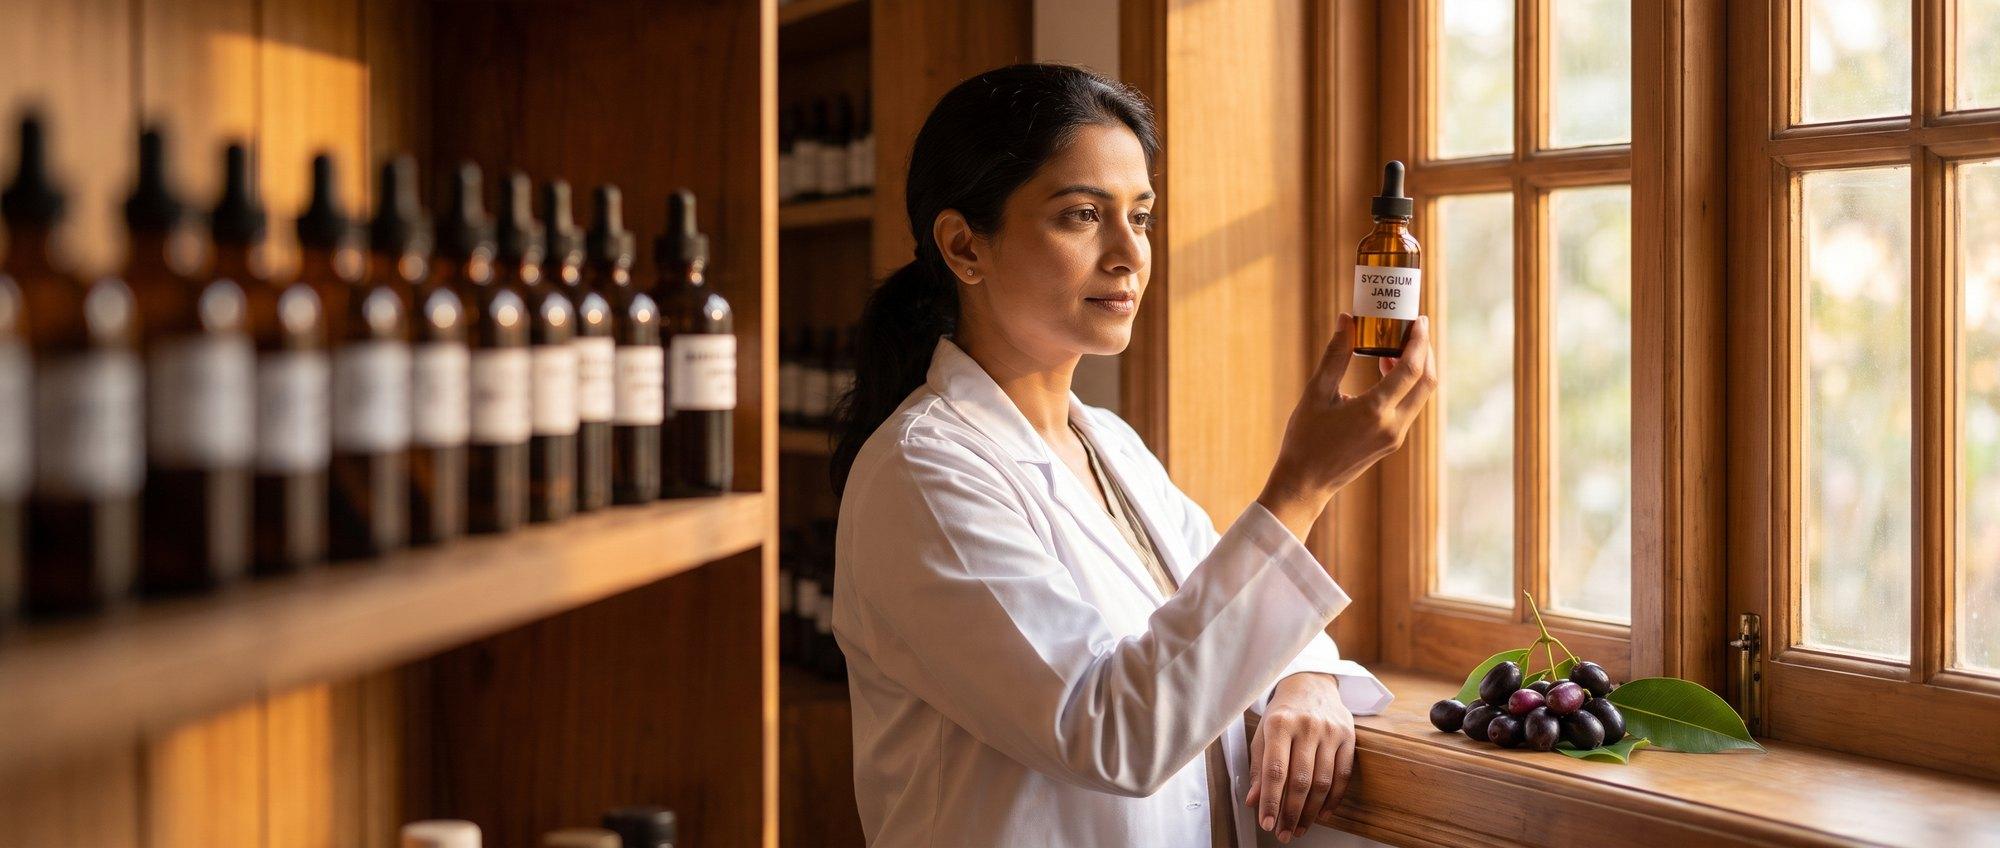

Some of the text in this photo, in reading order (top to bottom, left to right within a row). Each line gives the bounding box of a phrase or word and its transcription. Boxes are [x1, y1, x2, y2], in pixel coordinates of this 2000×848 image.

[1361, 274, 1412, 285] SYZYGIUM
[1371, 288, 1401, 298] JAMB
[1376, 300, 1396, 310] 30C
